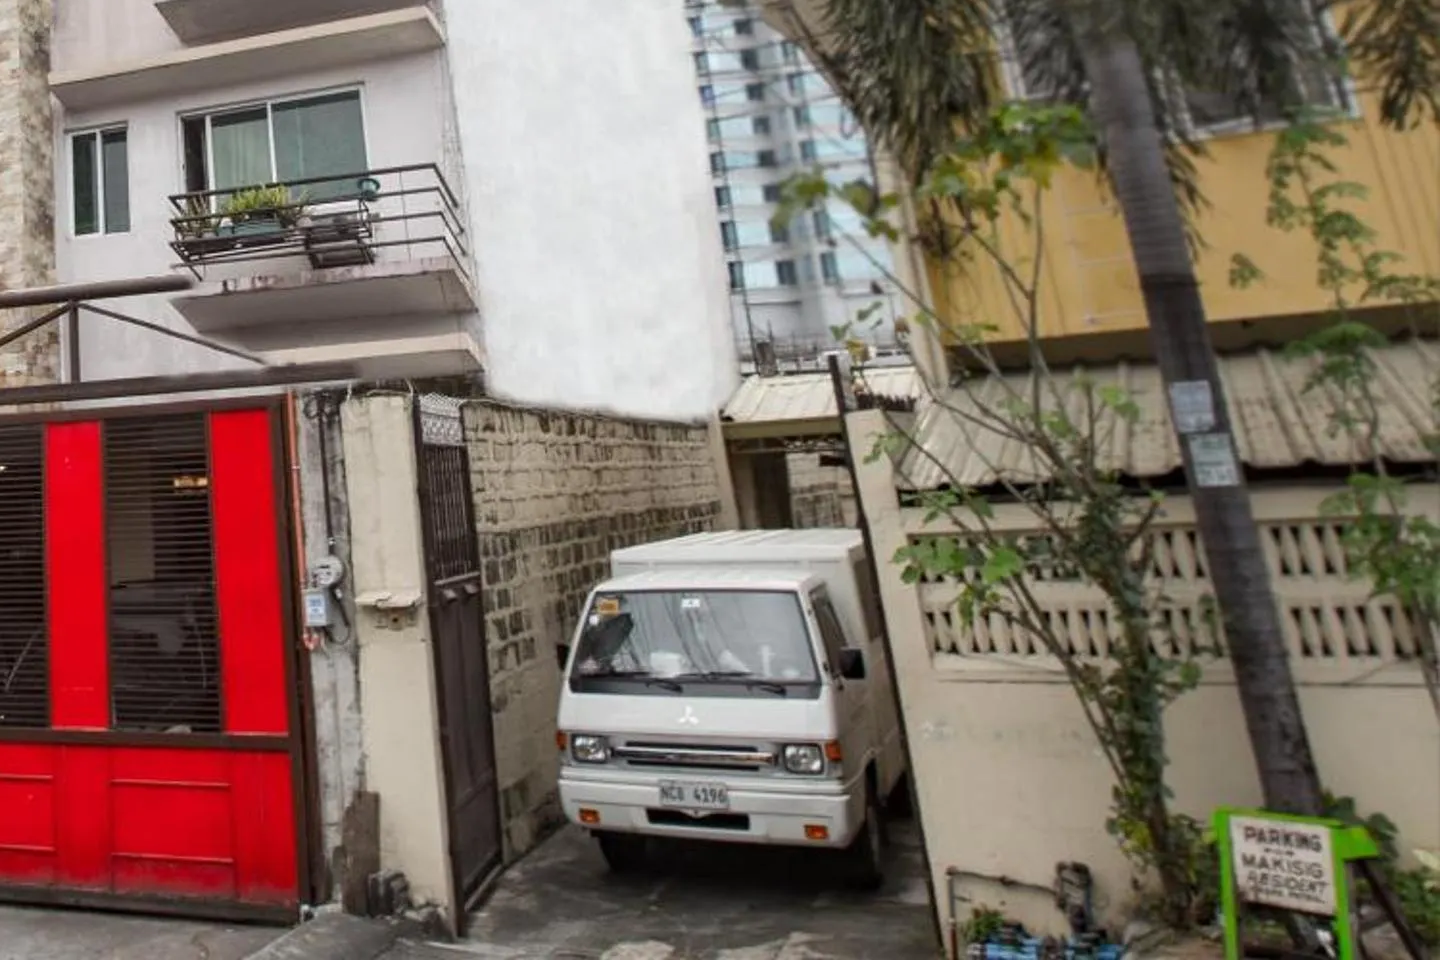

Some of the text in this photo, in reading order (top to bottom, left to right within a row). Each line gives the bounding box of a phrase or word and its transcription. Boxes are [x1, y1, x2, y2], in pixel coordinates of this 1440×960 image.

[1243, 825, 1323, 853] PARKING
[1241, 852, 1324, 880] MAKISIG
[1246, 870, 1330, 896] RESIDENT
